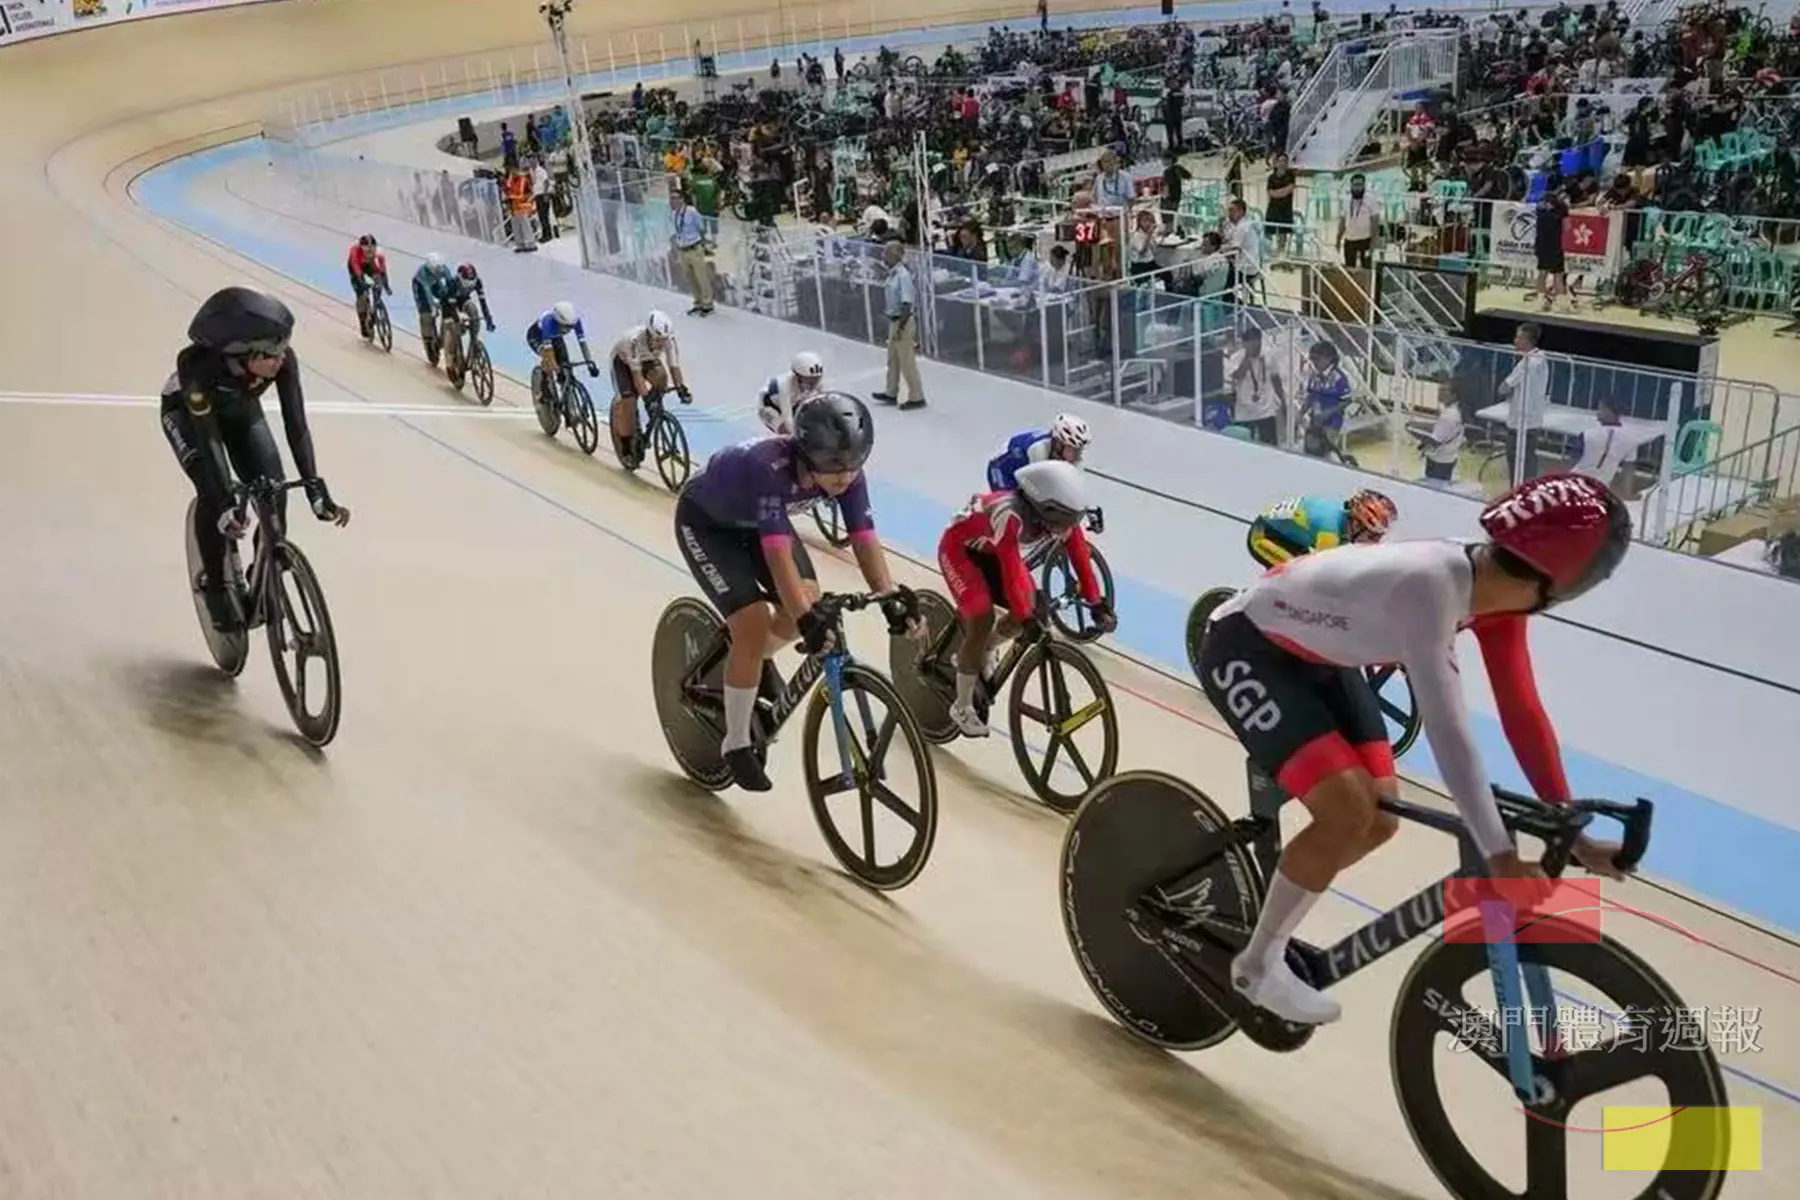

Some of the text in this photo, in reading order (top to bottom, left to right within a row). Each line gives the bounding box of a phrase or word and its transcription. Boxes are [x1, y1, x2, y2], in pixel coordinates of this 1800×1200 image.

[1075, 221, 1095, 241] 37
[680, 524, 731, 595] MACAU CHINA
[1211, 659, 1282, 732] SGP
